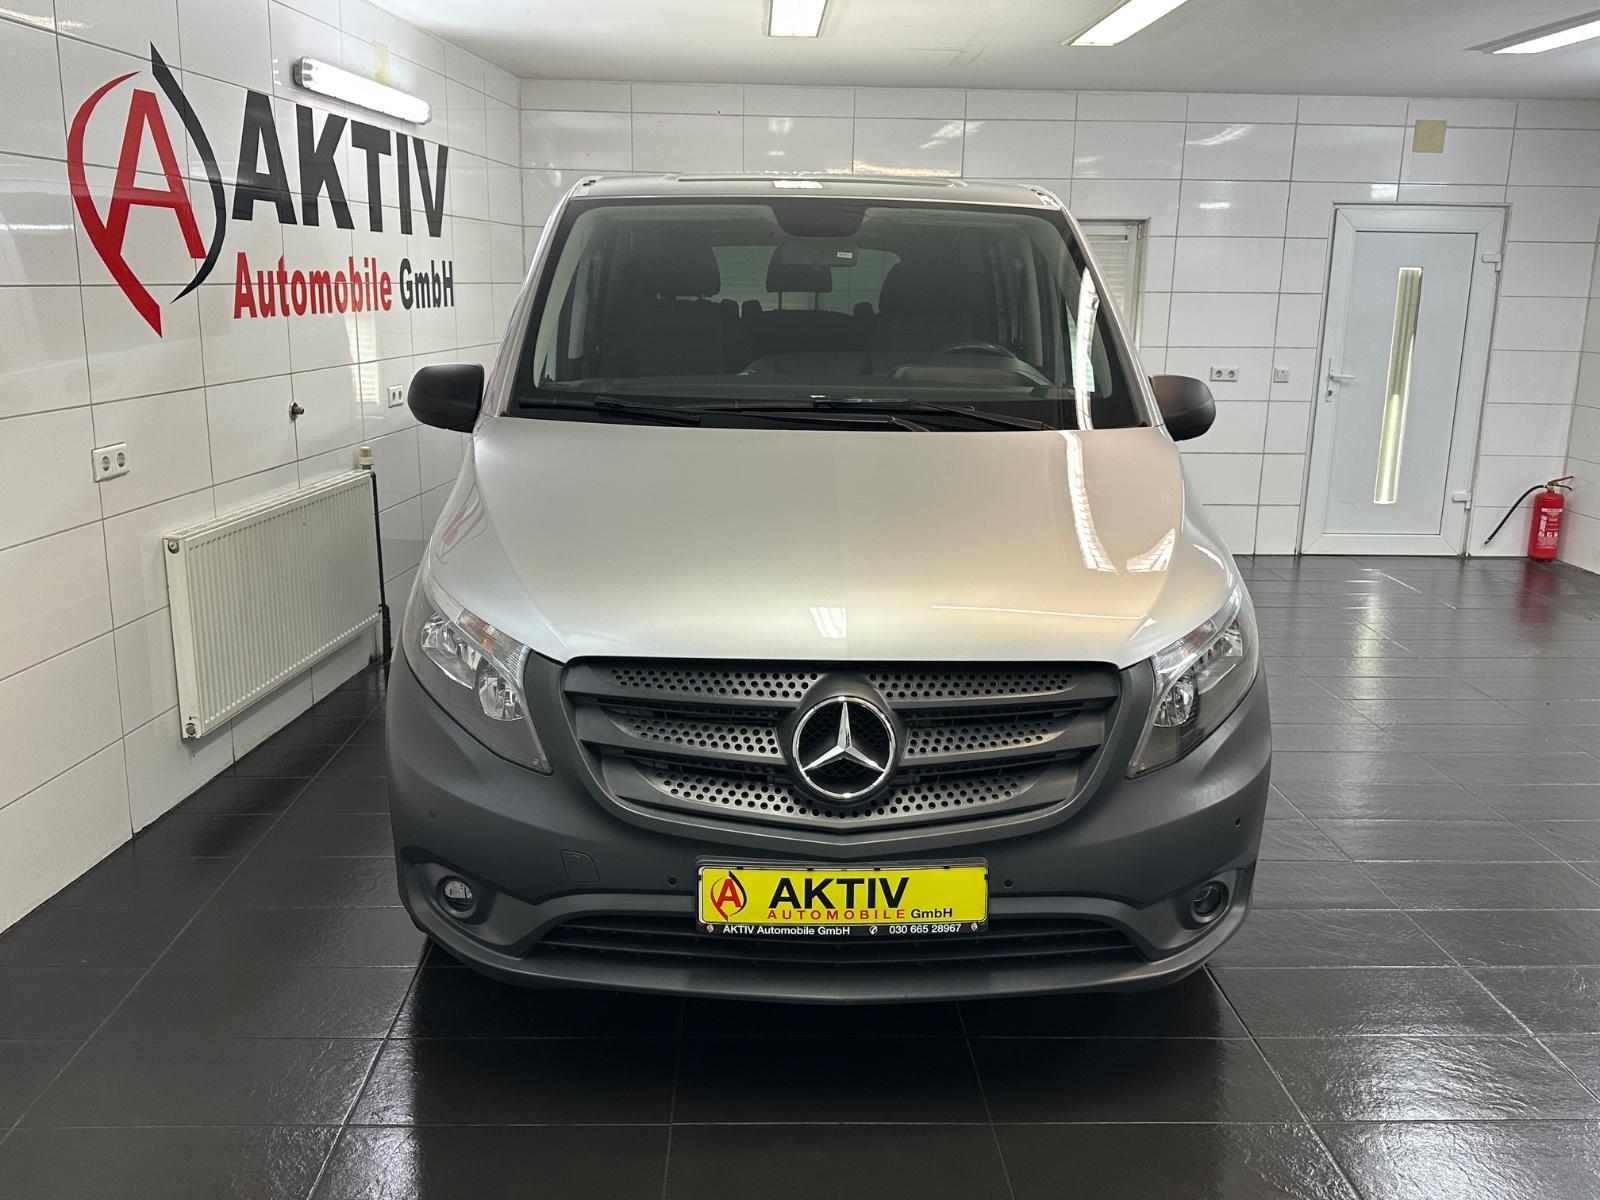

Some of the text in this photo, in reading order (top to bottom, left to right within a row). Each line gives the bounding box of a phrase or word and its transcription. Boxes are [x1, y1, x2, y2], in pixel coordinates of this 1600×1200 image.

[232, 89, 449, 238] AKTIV
[233, 252, 454, 319] Automobile GmbH
[768, 877, 909, 909] AKTIV
[723, 923, 961, 936] AKTIV Automobile GmbH 030 665 28967
[767, 907, 953, 920] AUTOMOBILE GmbH
